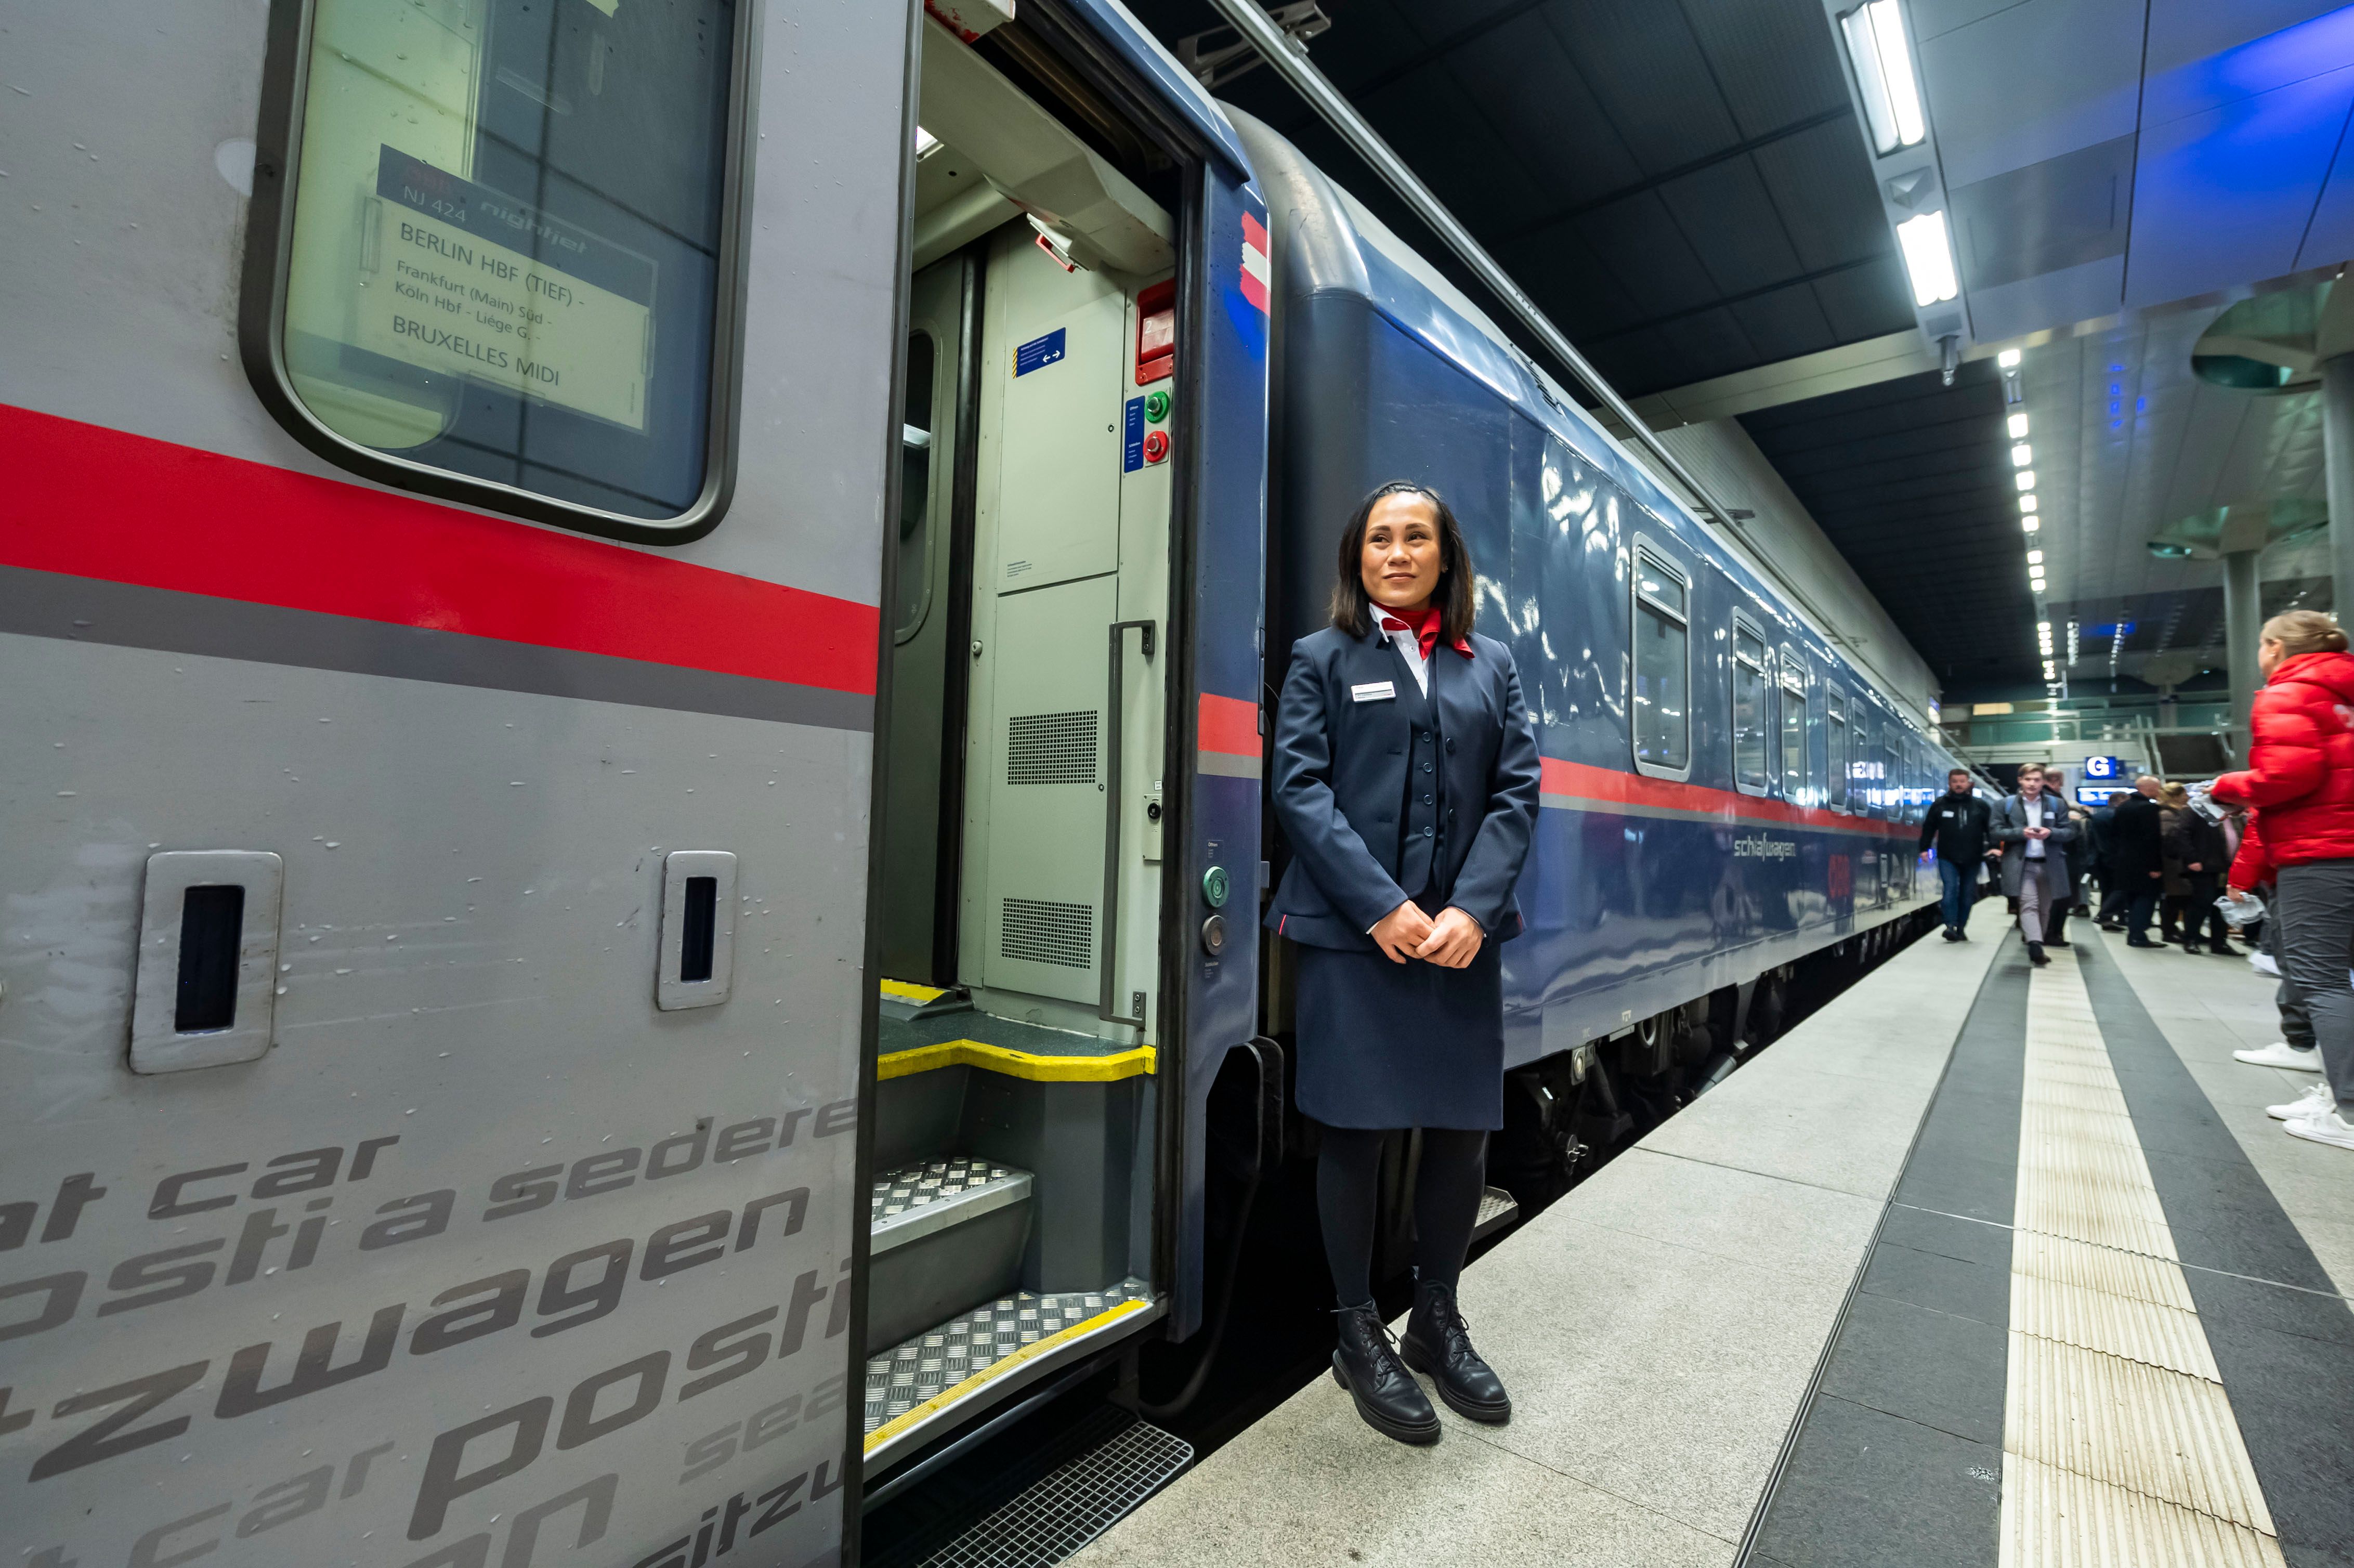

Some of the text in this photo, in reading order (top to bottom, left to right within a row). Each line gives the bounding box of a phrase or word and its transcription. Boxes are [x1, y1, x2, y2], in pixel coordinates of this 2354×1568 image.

[404, 185, 466, 223] NJ 424
[480, 201, 587, 254] nightjet
[397, 260, 465, 296] Frankfurt
[470, 287, 514, 315] (Main)
[518, 306, 543, 324] Süd
[400, 221, 473, 266] BERLIN
[481, 255, 519, 282] HBF
[525, 272, 572, 307] (TIEF)
[395, 281, 429, 304] Köln
[435, 295, 462, 315] Hbf
[517, 326, 531, 341] G.
[393, 315, 559, 386] BRUXELLES MIDI
[2087, 756, 2110, 776] G
[1734, 832, 1796, 862] schlafwagen
[147, 1134, 401, 1220] car
[359, 1188, 457, 1251] a
[482, 1097, 858, 1222] sedere
[407, 1257, 853, 1541] posti
[125, 1440, 396, 1568] car
